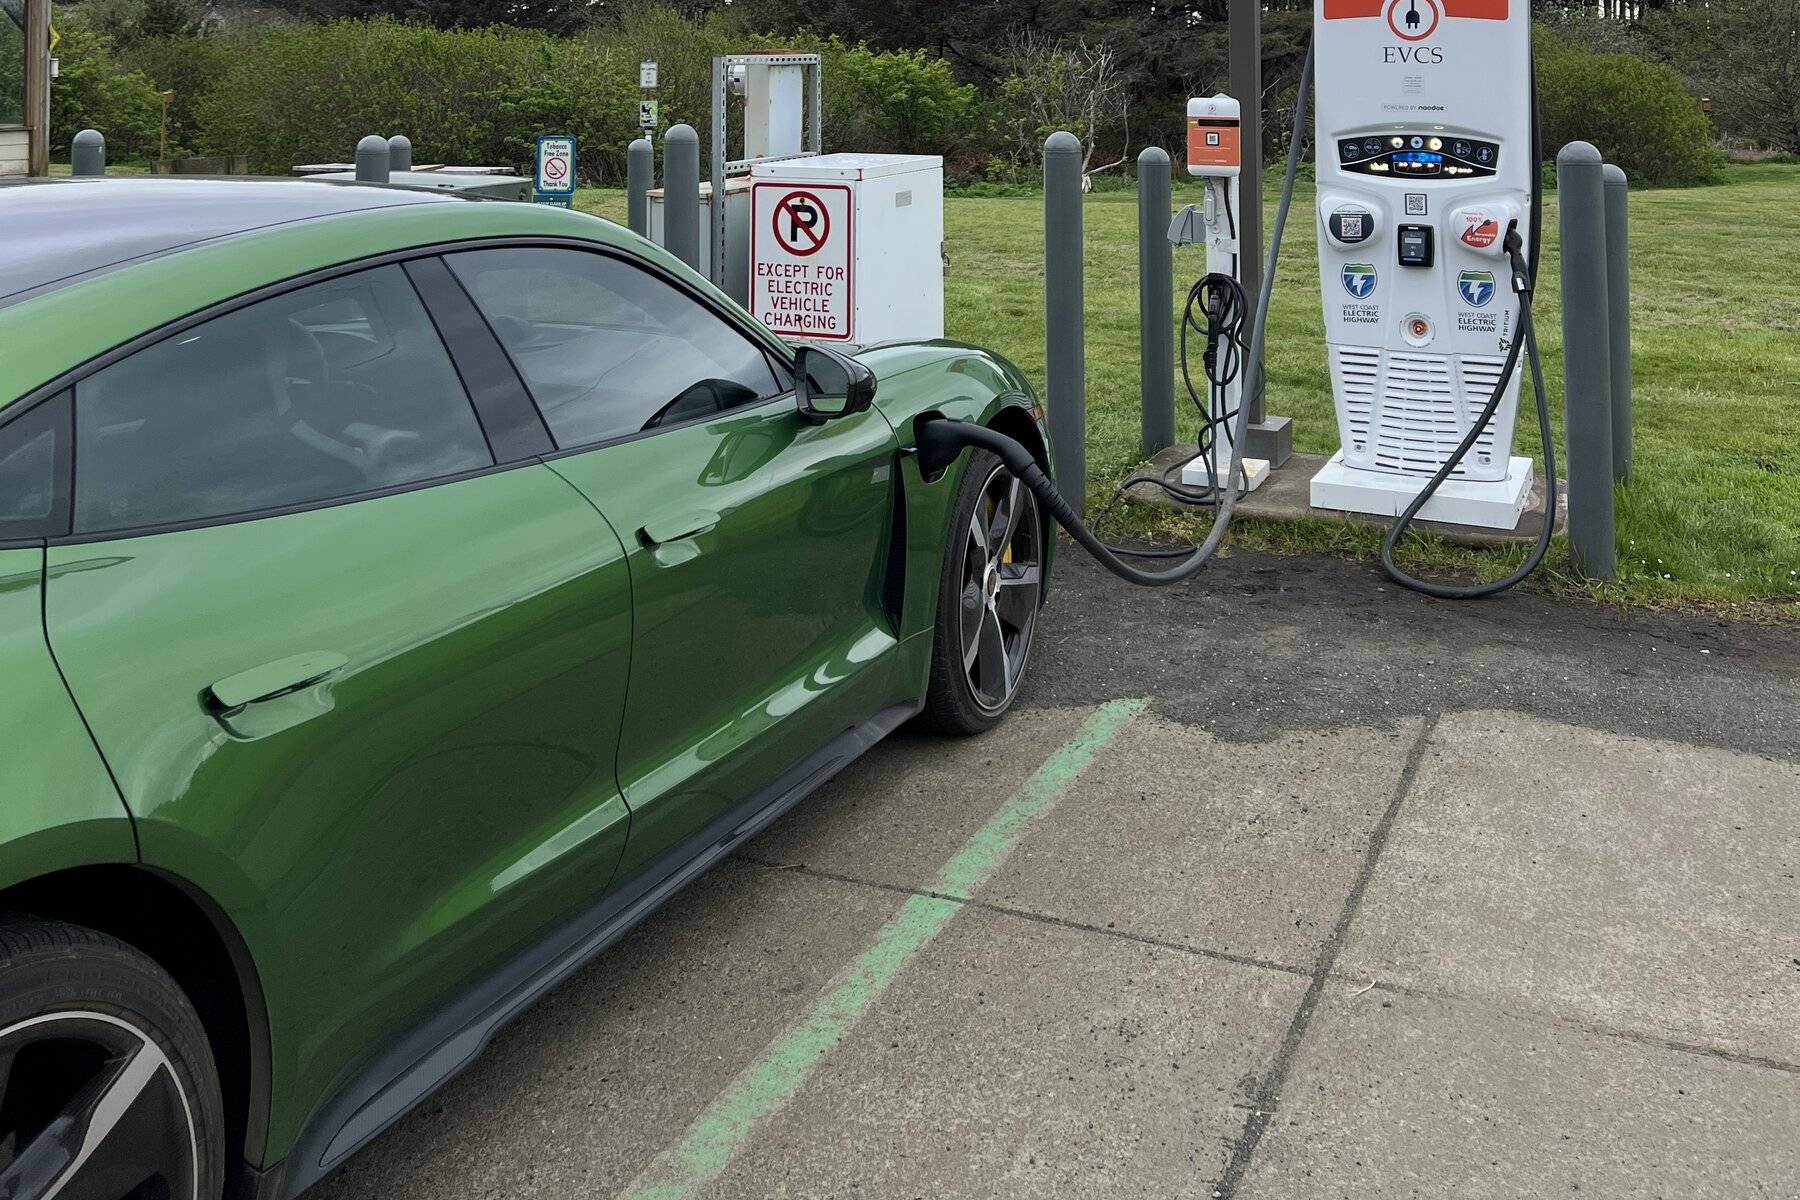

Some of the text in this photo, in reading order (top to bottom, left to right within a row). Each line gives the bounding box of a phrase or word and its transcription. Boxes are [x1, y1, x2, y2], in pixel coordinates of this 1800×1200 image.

[1382, 46, 1443, 64] EVCS
[546, 142, 567, 150] Tobacco
[559, 180, 568, 188] You
[1466, 235, 1491, 244] Energy
[757, 262, 844, 280] EXCEPT FOR
[768, 280, 833, 296] ELECTRIC
[771, 296, 830, 313] VEHICLE
[764, 312, 836, 330] CHARGING
[1458, 318, 1496, 326] ELECTRIC
